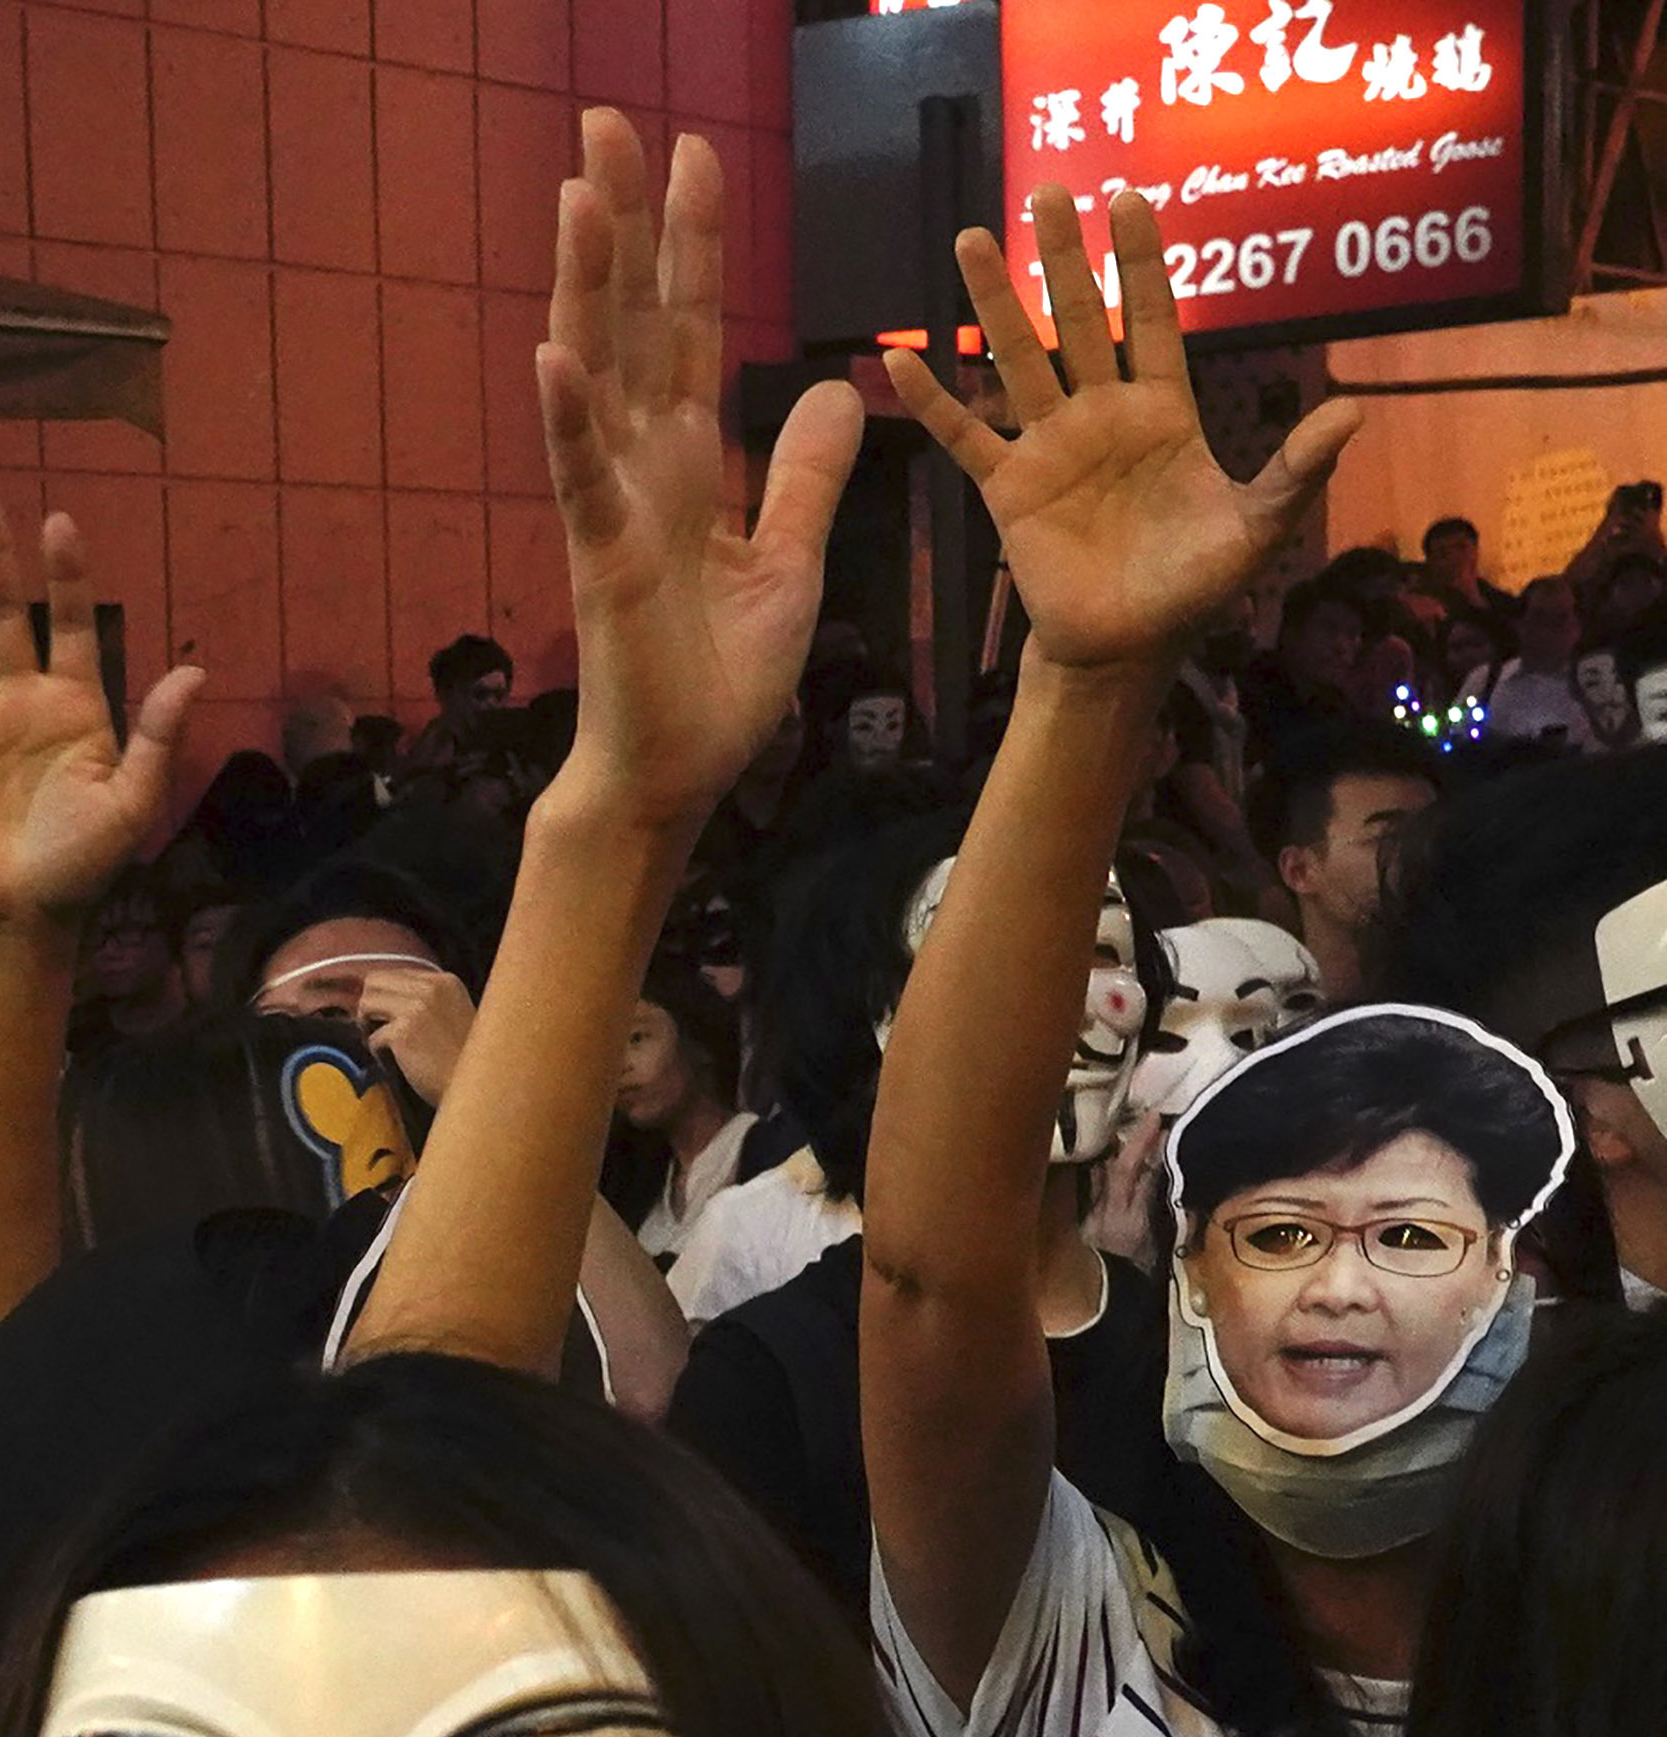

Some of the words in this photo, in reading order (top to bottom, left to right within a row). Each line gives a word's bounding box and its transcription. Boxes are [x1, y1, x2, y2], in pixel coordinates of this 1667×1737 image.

[1180, 164, 1250, 204] Chan
[1255, 157, 1308, 189] Kee
[1315, 140, 1424, 181] Roasted
[1428, 131, 1505, 174] Goose
[1165, 228, 1314, 300] 2267
[1334, 206, 1493, 278] 0666
